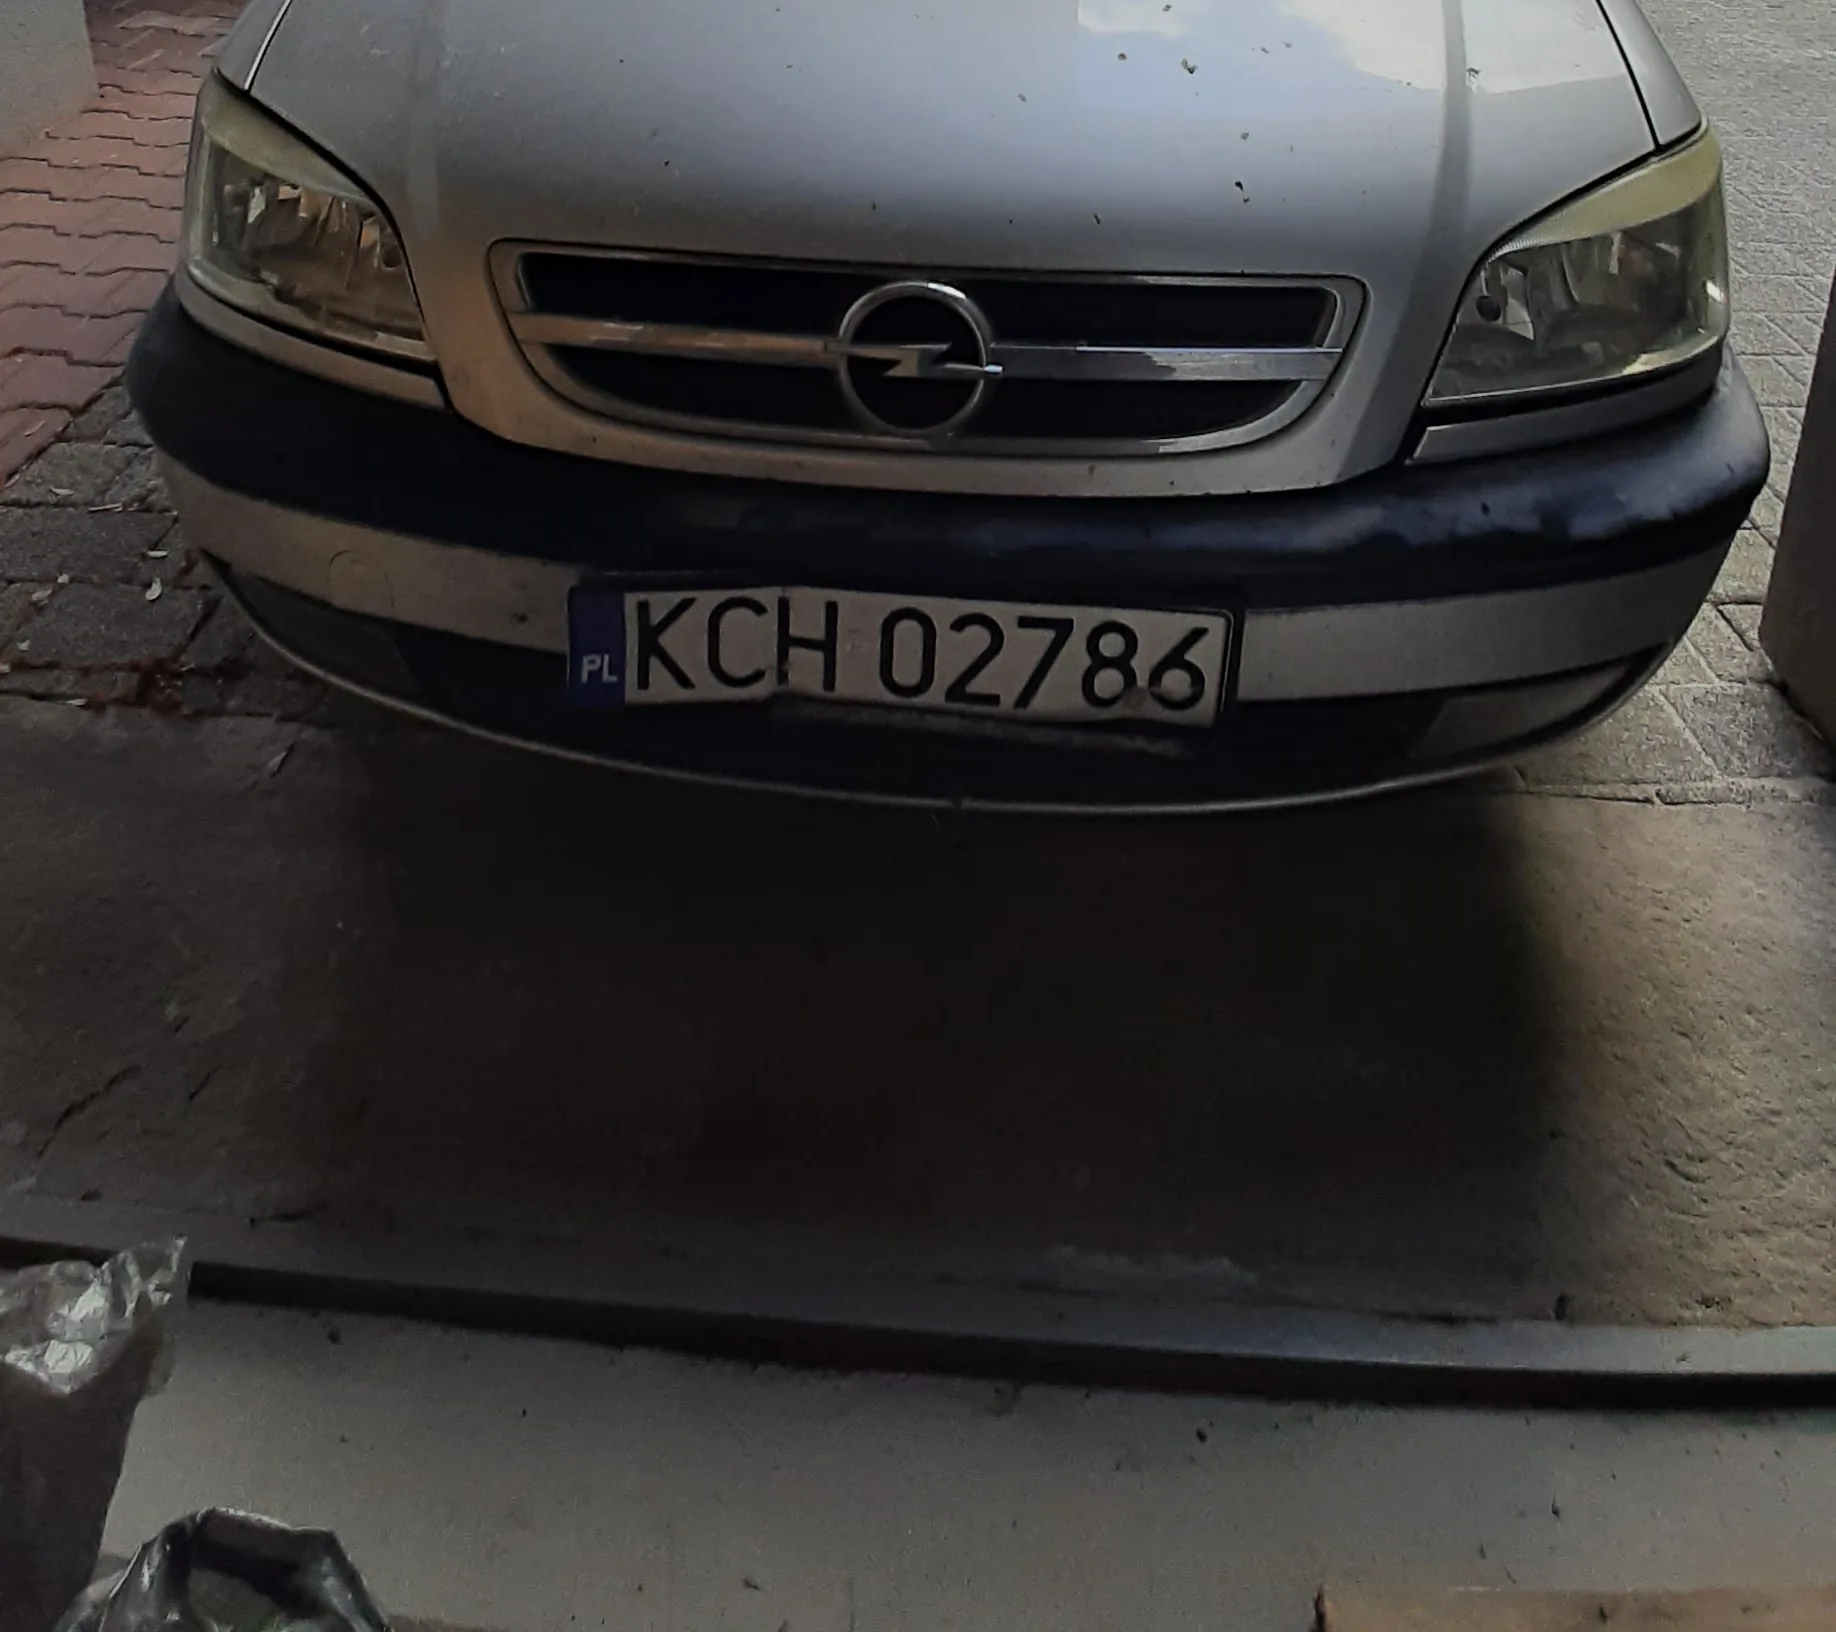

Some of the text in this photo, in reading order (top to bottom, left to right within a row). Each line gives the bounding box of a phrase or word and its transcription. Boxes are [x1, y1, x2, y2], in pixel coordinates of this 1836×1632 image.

[580, 653, 619, 684] PL
[636, 596, 1210, 712] KCH 02786
